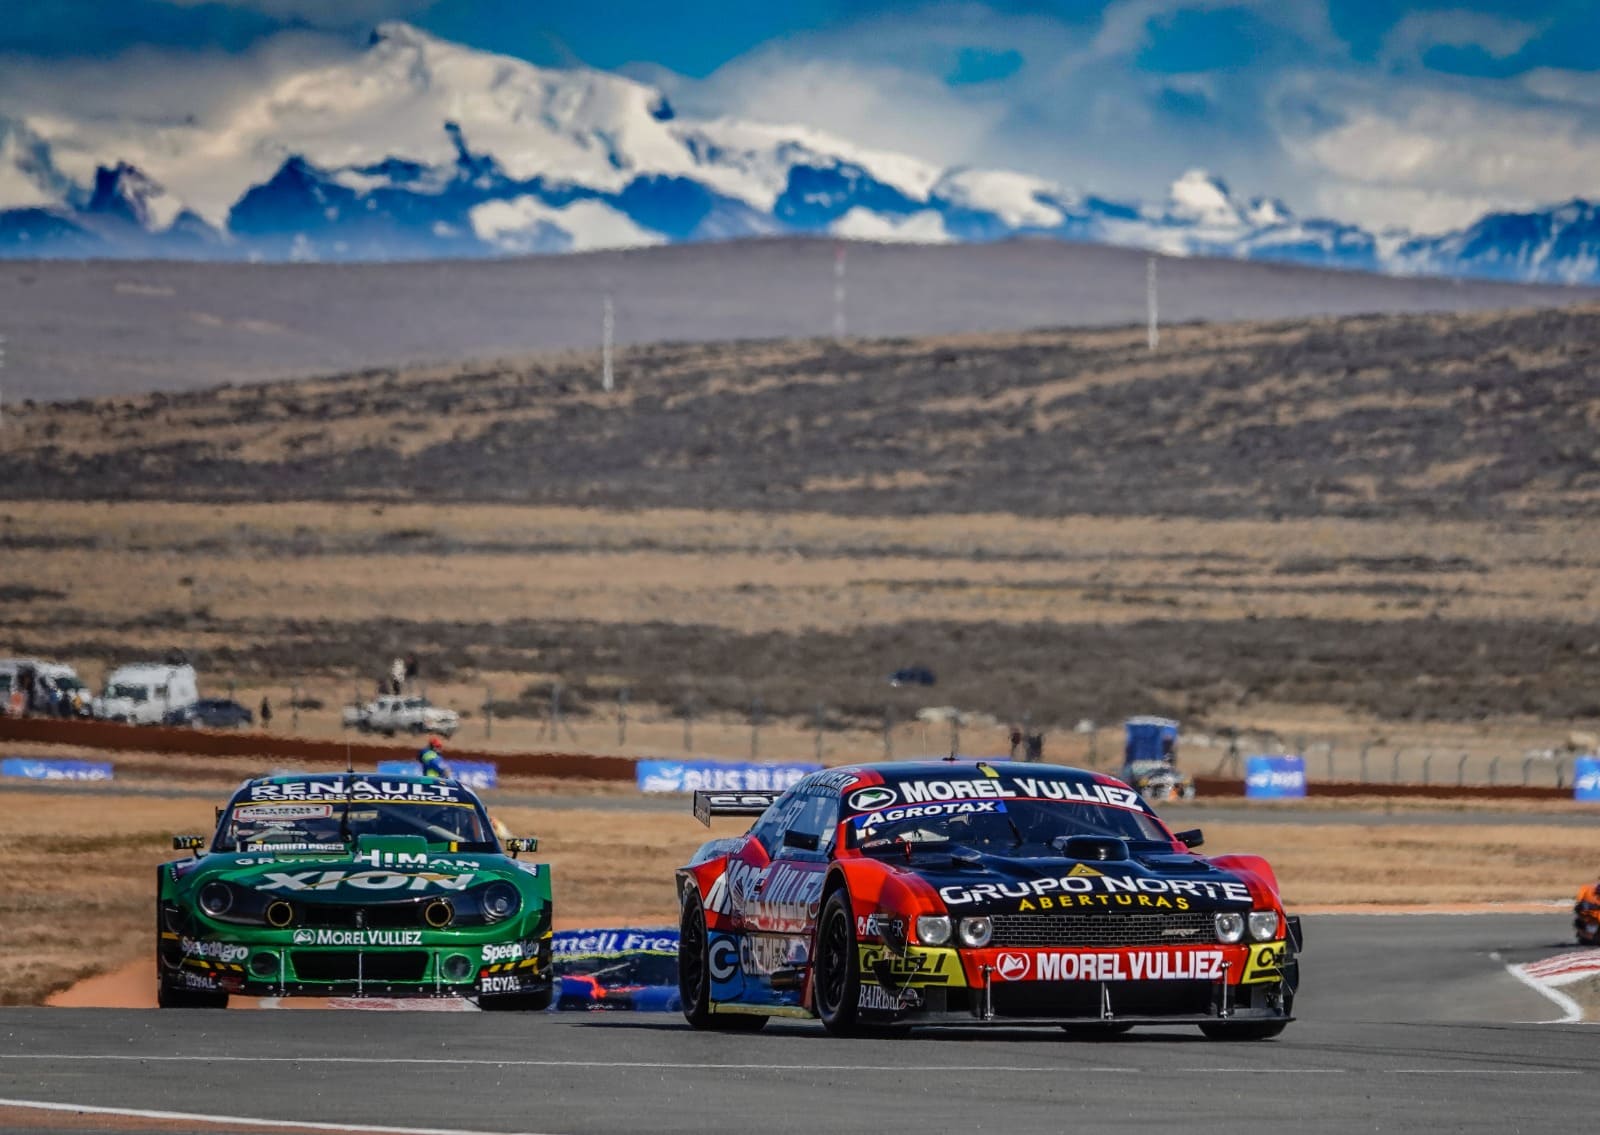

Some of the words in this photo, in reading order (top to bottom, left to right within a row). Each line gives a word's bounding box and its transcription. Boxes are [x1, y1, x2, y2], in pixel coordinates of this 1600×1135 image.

[251, 780, 459, 797] RENAULT
[252, 793, 459, 802] CONCESONARIOS
[900, 779, 1016, 802] MOREL
[1013, 778, 1144, 812] VULLIEZ
[862, 801, 996, 828] AGROTAX
[353, 849, 480, 867] HIMAN
[255, 871, 475, 890] XION
[938, 877, 1093, 904] GRUPO
[1099, 876, 1254, 903] NORTE
[1019, 894, 1191, 911] ABERTURAS
[317, 930, 367, 945] MOREL
[368, 930, 422, 945] VULLIEZ
[1036, 952, 1126, 980] MOREL
[1129, 951, 1225, 979] VULLIEZ
